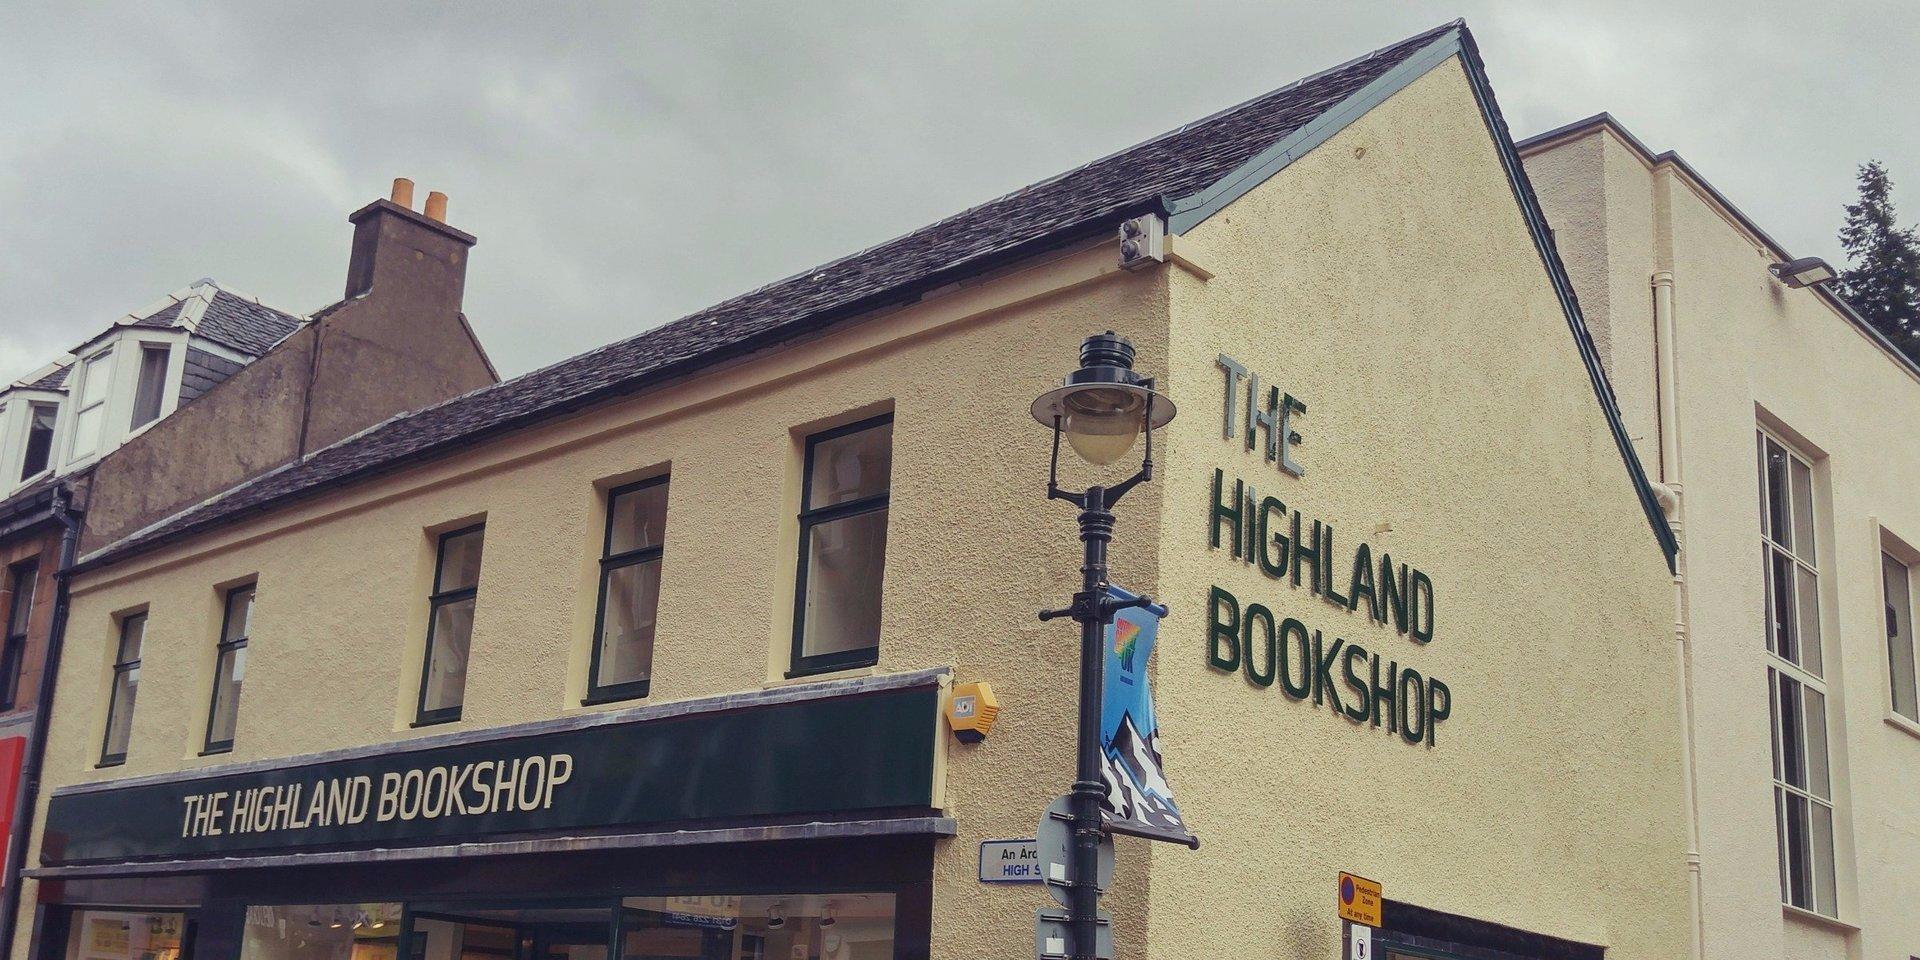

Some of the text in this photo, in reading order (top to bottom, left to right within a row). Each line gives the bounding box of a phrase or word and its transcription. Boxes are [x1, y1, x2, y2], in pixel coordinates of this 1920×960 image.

[1217, 353, 1306, 478] THE
[1211, 467, 1435, 644] HIGHLAND
[1210, 584, 1451, 747] BOOKSHOP
[181, 753, 573, 838] THE HIGHLAND BOOKSHOP
[1001, 848, 1016, 860] An
[1003, 863, 1041, 876] HIGH S
[1356, 883, 1380, 898] Pedestrian
[1362, 896, 1374, 907] Zone
[1346, 907, 1374, 922] At any time
